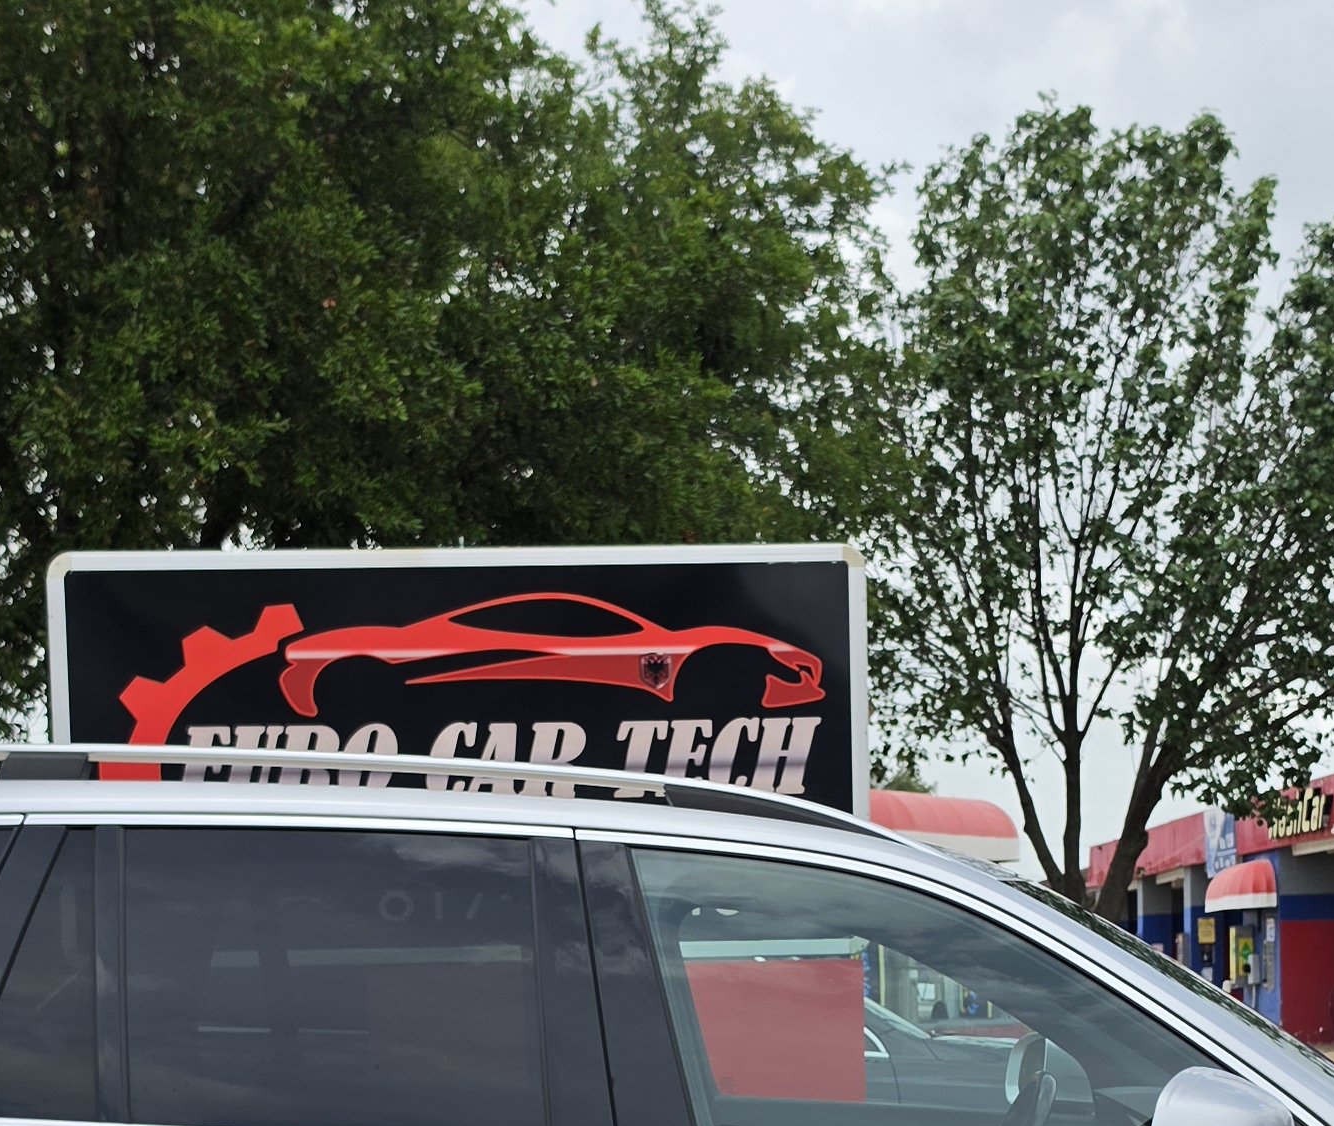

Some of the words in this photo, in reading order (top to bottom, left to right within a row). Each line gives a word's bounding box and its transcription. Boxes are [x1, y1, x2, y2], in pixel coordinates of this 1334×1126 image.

[182, 723, 398, 788] EURO
[424, 721, 586, 798] CAR
[613, 716, 822, 799] TECH
